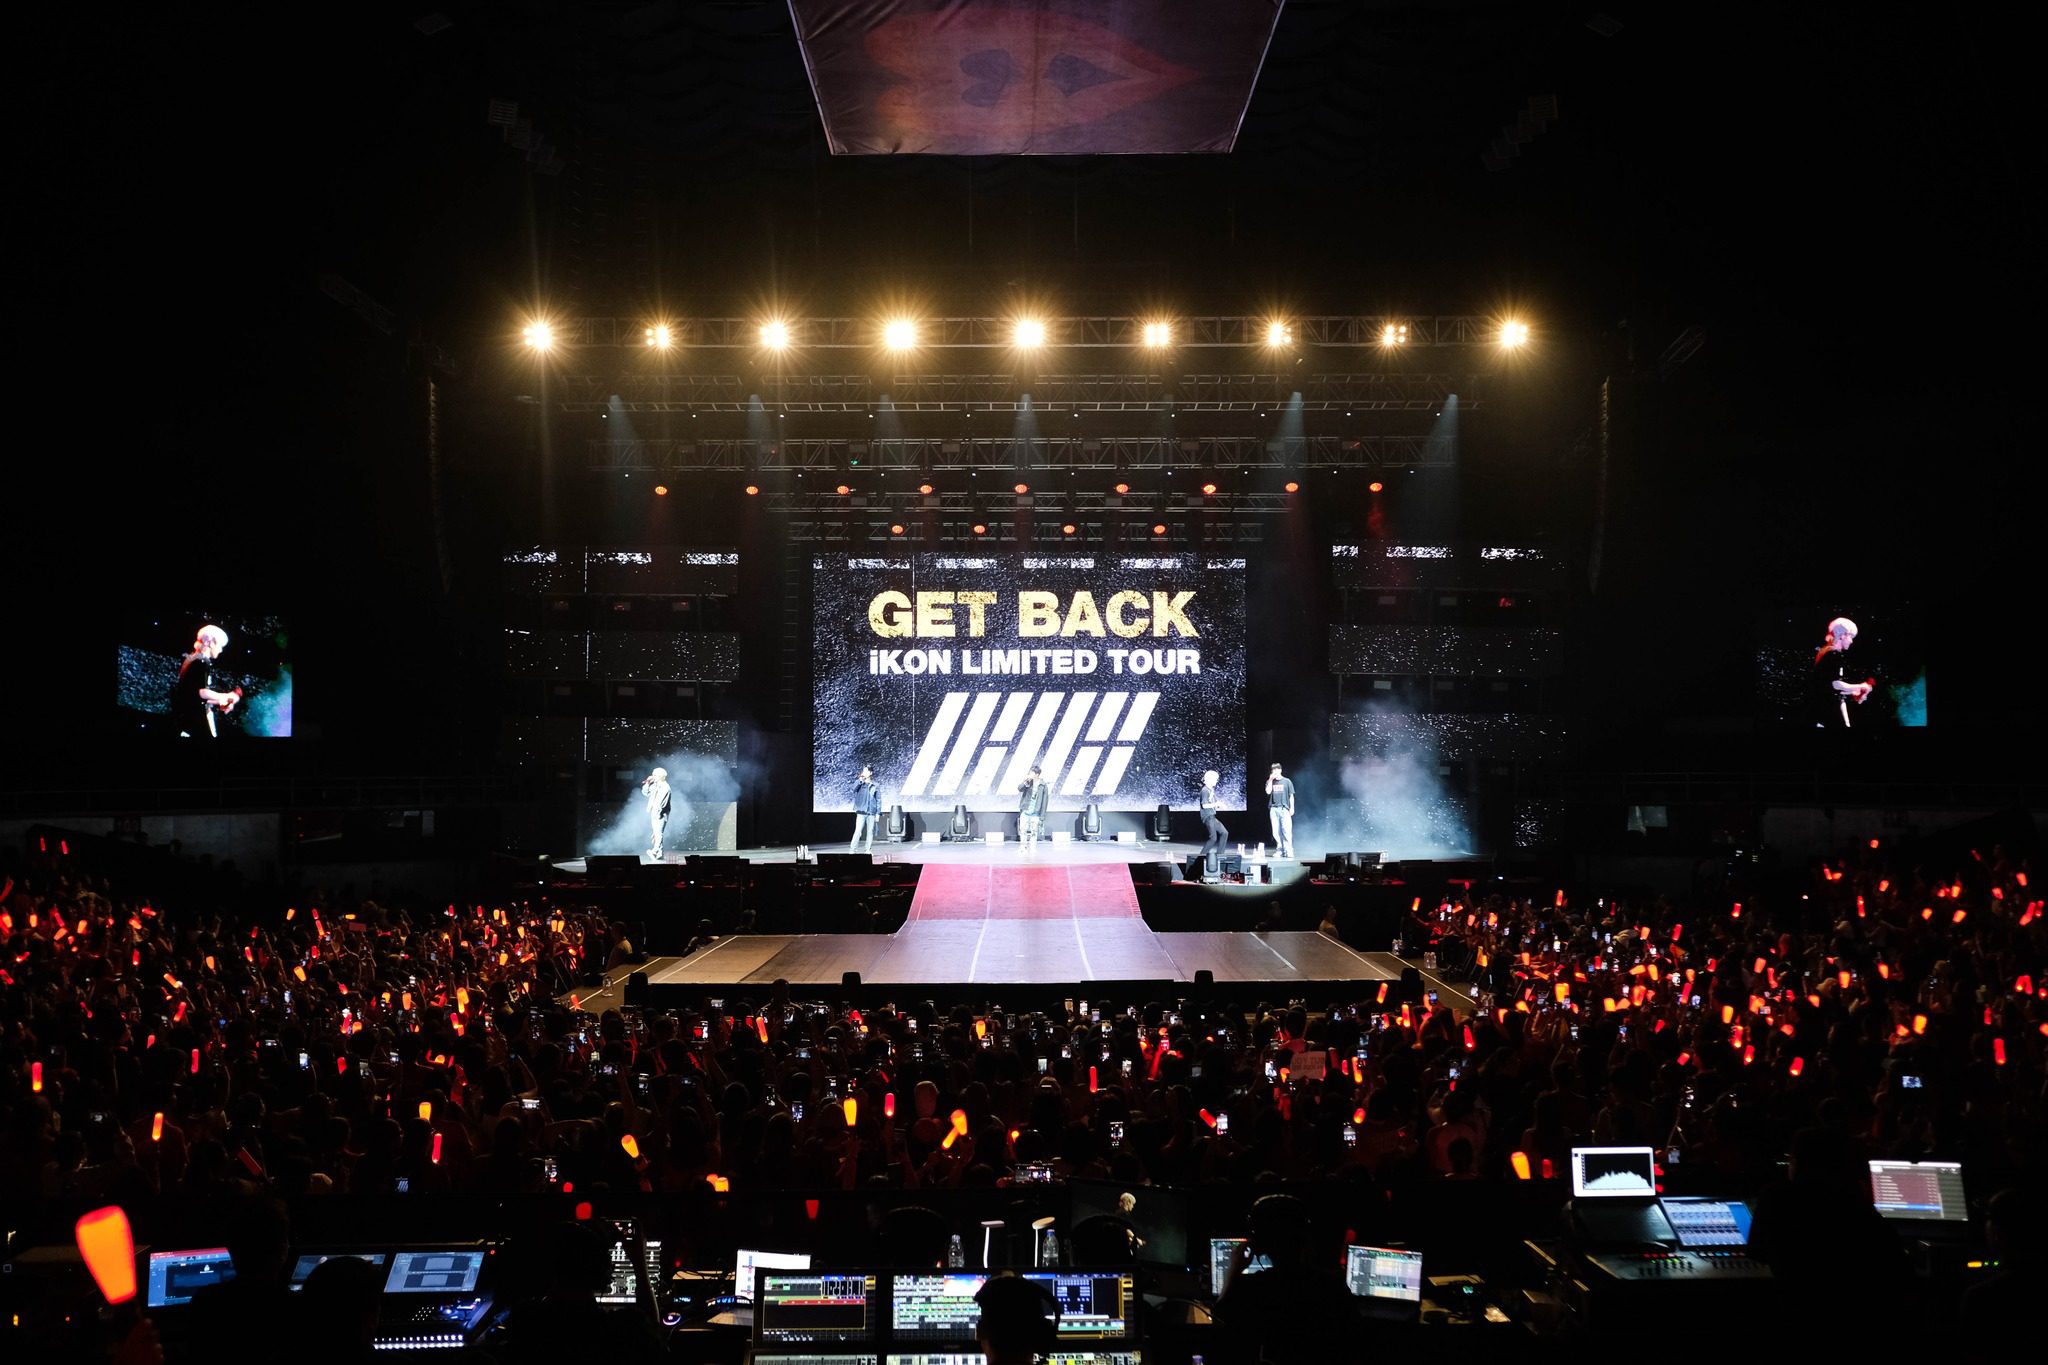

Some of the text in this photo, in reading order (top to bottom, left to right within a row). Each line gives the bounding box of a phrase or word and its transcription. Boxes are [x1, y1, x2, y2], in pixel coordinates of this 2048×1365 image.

[868, 590, 1200, 638] GET BACK
[869, 649, 1200, 675] iKON LIMITED TOUR
